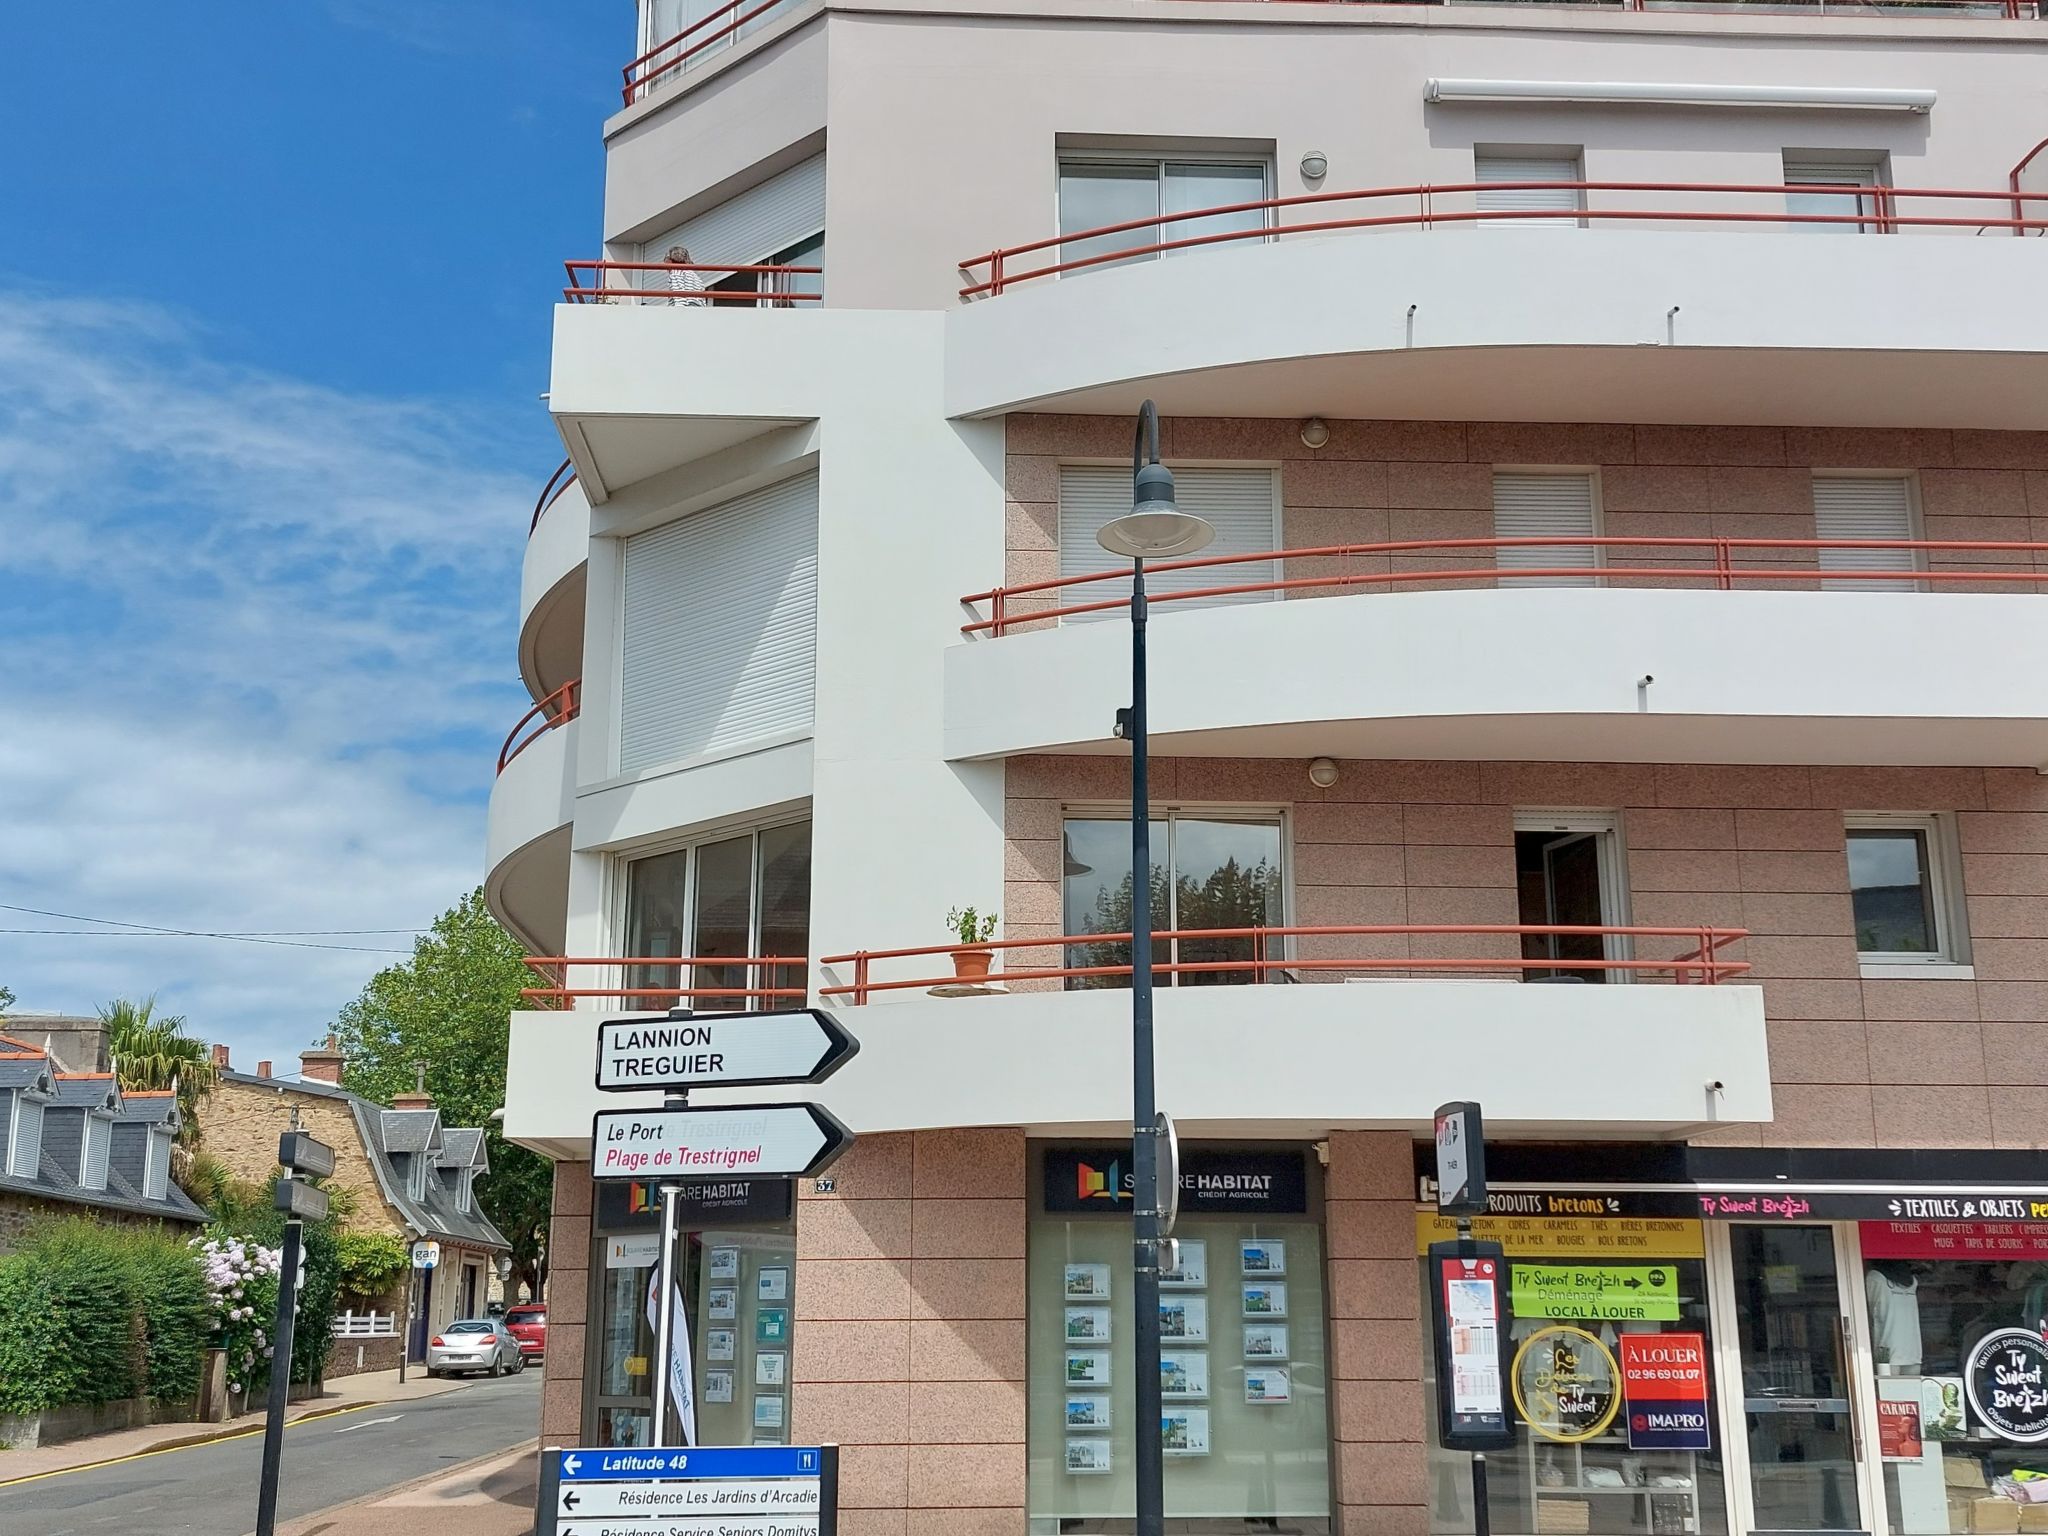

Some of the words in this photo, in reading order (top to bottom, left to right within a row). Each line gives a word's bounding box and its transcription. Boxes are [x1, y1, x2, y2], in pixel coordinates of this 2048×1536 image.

[614, 1027, 712, 1050] LANNION
[613, 1053, 724, 1077] TREGUIER
[607, 1123, 624, 1141] Le
[629, 1123, 664, 1141] Port
[605, 1148, 649, 1171] Plage
[654, 1148, 673, 1165] de
[679, 1145, 762, 1169] Trestrignel
[702, 1182, 751, 1199] HABITAT
[818, 1180, 833, 1191] 37
[1197, 1175, 1272, 1189] HABITAT
[1548, 1195, 1604, 1213] bretons
[1699, 1197, 1716, 1216] Ty
[1720, 1195, 1757, 1213] Sweat
[1903, 1199, 1959, 1218] TEXTILES
[1962, 1201, 1977, 1218] &
[1979, 1199, 2026, 1217] OBJETS
[1508, 1220, 1530, 1230] CIDRES
[1544, 1220, 1578, 1231] CARAMELS
[1646, 1221, 1684, 1232] BRETONNES
[1890, 1223, 1921, 1233] TEXTILES
[1931, 1224, 1974, 1234] CASQUETTES
[1983, 1224, 2013, 1234] TABLIERS
[1529, 1235, 1544, 1245] MER
[1557, 1235, 1585, 1246] BOUGIES
[1617, 1236, 1647, 1247] BRETONS
[1934, 1238, 1954, 1248] MUGS
[1965, 1238, 1983, 1248] TAPIS
[1985, 1238, 1995, 1248] DE
[1998, 1238, 2023, 1249] SOURIS
[416, 1249, 437, 1261] gan
[1515, 1272, 1529, 1288] Ty
[1534, 1270, 1569, 1286] Sweat
[1538, 1288, 1603, 1303] Déménage
[1545, 1306, 1587, 1318] LOCAL
[1603, 1306, 1646, 1318] LOUER
[1628, 1345, 1640, 1362] À
[1642, 1349, 1698, 1363] LOUER
[1976, 1341, 2002, 1369] Textiles
[2006, 1349, 2027, 1372] Ty
[1628, 1369, 1641, 1379] 02
[1642, 1369, 1657, 1379] 96
[1657, 1369, 1671, 1379] 69
[1672, 1369, 1686, 1379] 01
[1686, 1369, 1700, 1379] 07
[1995, 1364, 2042, 1385] Sweat
[1569, 1384, 1585, 1402] Ty
[1559, 1396, 1597, 1413] Sweat
[1879, 1403, 1918, 1417] CARMEN
[1648, 1413, 1705, 1428] IMAPRO
[1987, 1407, 2013, 1429] Objets
[602, 1455, 665, 1471] Latitude
[669, 1455, 688, 1470] 48
[618, 1491, 683, 1505] Résidence
[686, 1490, 708, 1504] Les
[711, 1489, 757, 1504] Jardins
[760, 1489, 818, 1503] d'Arcadie
